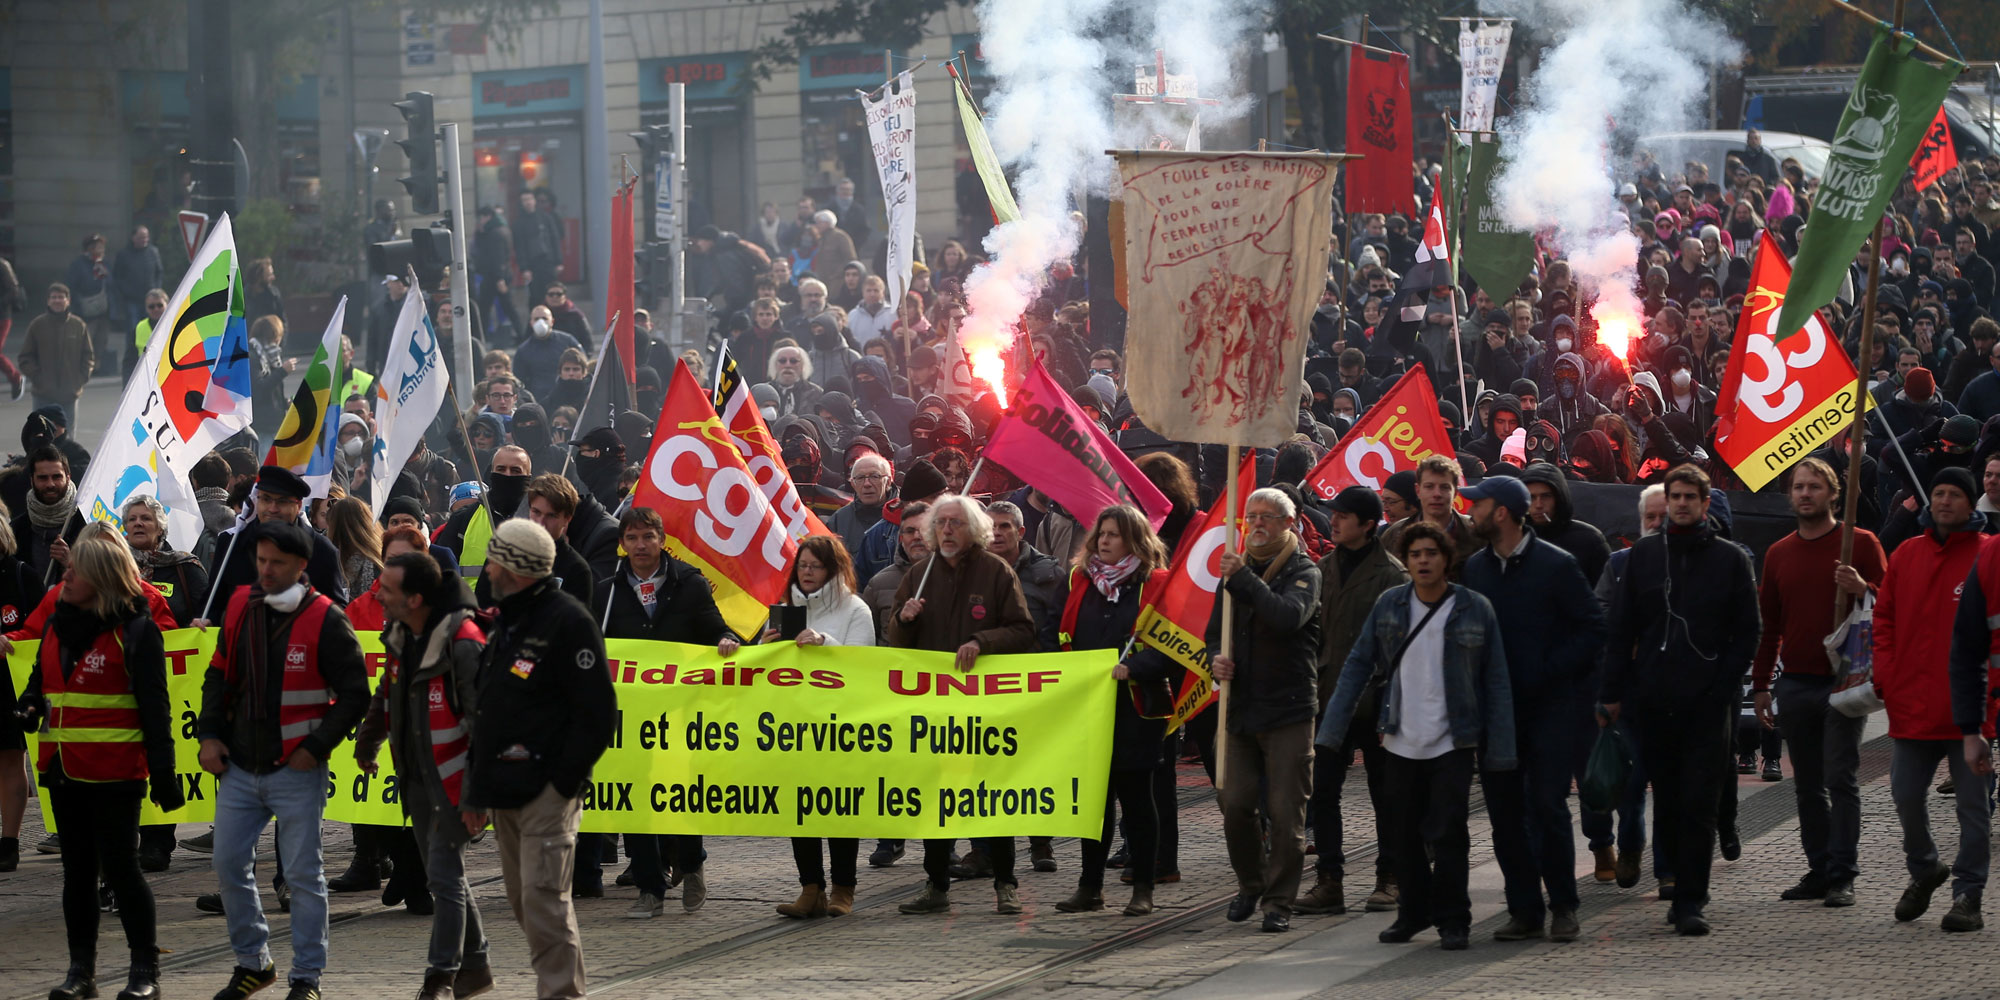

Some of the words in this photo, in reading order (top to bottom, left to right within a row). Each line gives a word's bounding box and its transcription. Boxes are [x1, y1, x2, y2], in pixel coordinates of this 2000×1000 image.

[1162, 165, 1210, 185] FOULE
[1222, 160, 1250, 175] LES
[1263, 159, 1324, 180] RAISINS
[1820, 158, 1883, 200] NTAISES
[1159, 195, 1173, 207] DE
[1183, 187, 1201, 199] LA
[1215, 175, 1273, 193] COLÈRE
[1164, 206, 1201, 225] POUR
[1211, 198, 1240, 210] QUE
[1817, 191, 1870, 221] LUTTE
[1161, 216, 1241, 244] FERMENTE
[1252, 213, 1267, 225] LA
[1479, 221, 1493, 232] EN
[1168, 235, 1229, 261] REVOLTE
[650, 434, 788, 572] cgt
[2, 608, 19, 624] cgt
[84, 652, 107, 669] cgt
[287, 651, 305, 664] cgt
[514, 659, 535, 673] cgt
[607, 659, 846, 689] lidaires
[888, 669, 1062, 696] UNEF
[181, 700, 198, 740] à
[639, 711, 669, 750] et
[686, 711, 739, 751] des
[756, 711, 893, 752] Services
[910, 715, 1018, 756] Publics
[582, 780, 634, 811] aux
[650, 774, 780, 815] cadeaux
[796, 786, 865, 826] pour
[878, 776, 922, 817] les
[938, 780, 1055, 827] patrons
[1072, 777, 1079, 815] !
